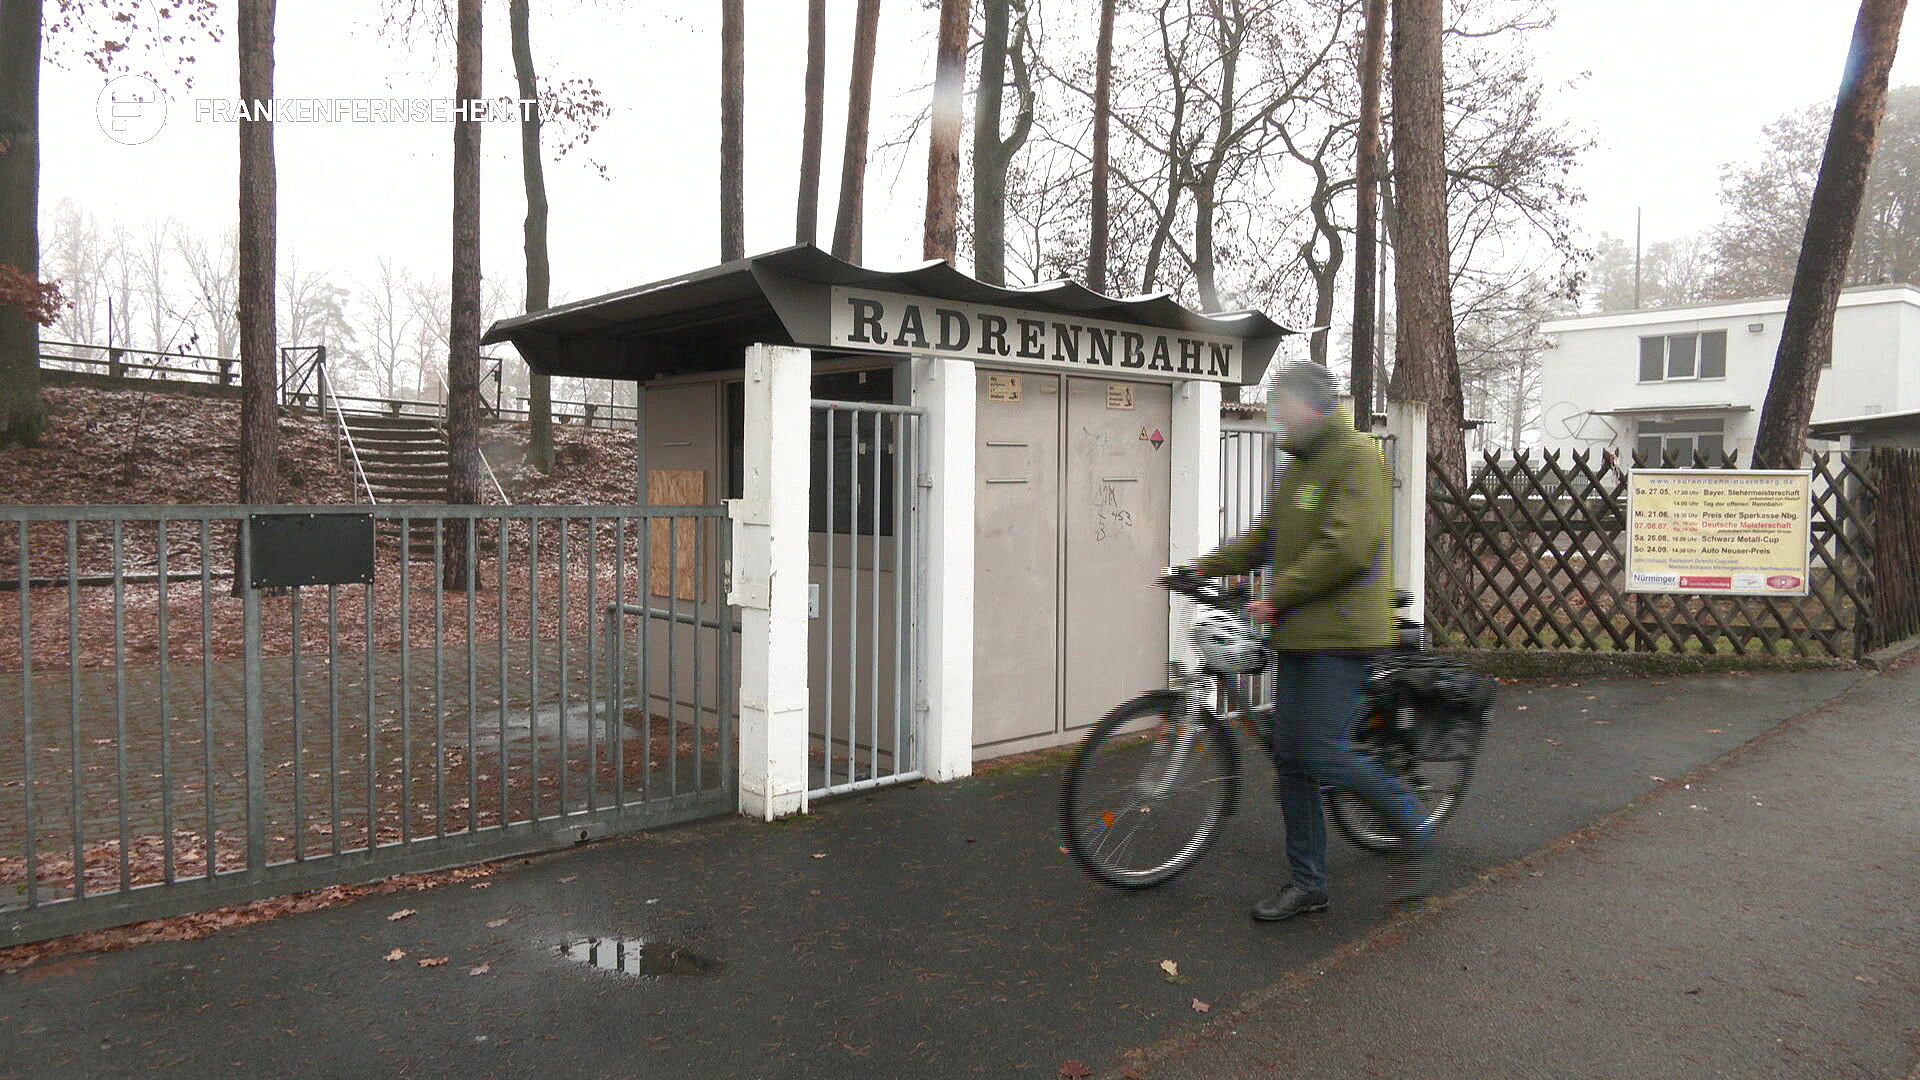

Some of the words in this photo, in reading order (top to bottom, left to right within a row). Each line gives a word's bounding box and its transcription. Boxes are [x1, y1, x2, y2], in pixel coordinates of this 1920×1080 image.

[847, 297, 1233, 378] RADRENNBAHN
[1648, 488, 1671, 496] 27.05.
[1703, 489, 1726, 497] Bayer.
[1739, 512, 1780, 520] Sparkasse
[1781, 513, 1799, 521] Nbg.
[1634, 534, 1646, 542] Sa.
[1737, 536, 1779, 544] Metall-Cup
[1634, 574, 1676, 583] Nürminger
